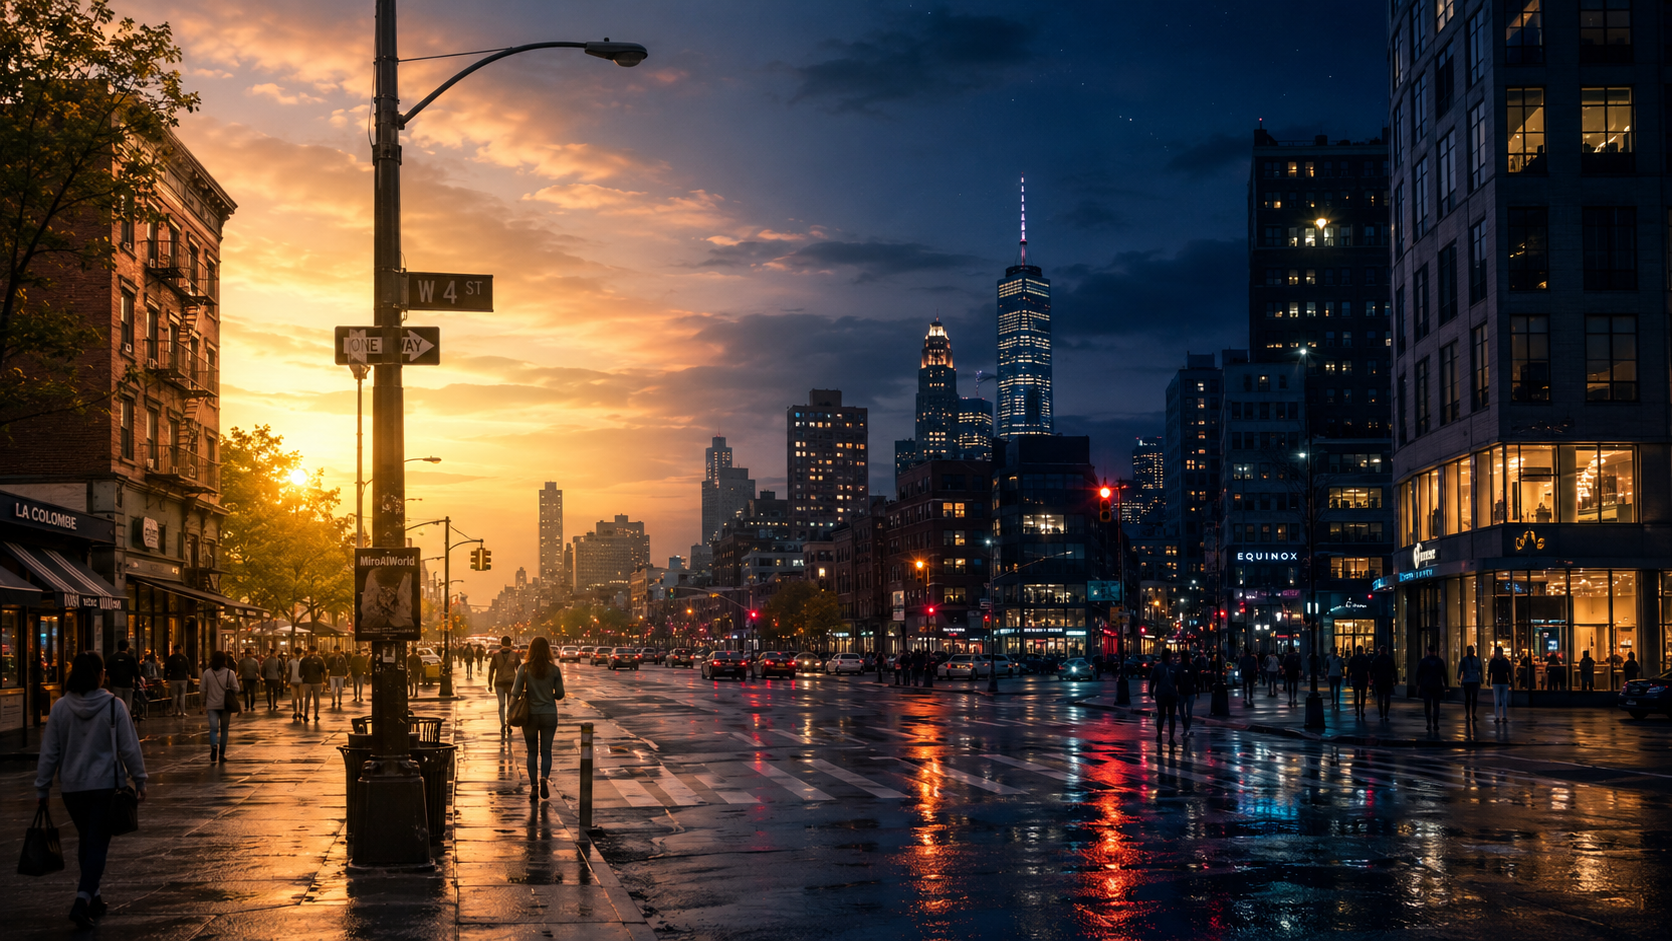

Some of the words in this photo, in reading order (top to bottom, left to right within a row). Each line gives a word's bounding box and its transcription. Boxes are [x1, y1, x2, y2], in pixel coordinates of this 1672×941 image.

[418, 280, 435, 303] W
[443, 280, 457, 304] 4
[465, 281, 483, 295] ST
[351, 338, 378, 352] ONE
[401, 339, 422, 352] AY
[16, 503, 30, 519] LA
[31, 507, 77, 530] COLOMBE
[360, 555, 415, 566] MiroAIWorld
[1237, 552, 1297, 562] EQUINOX
